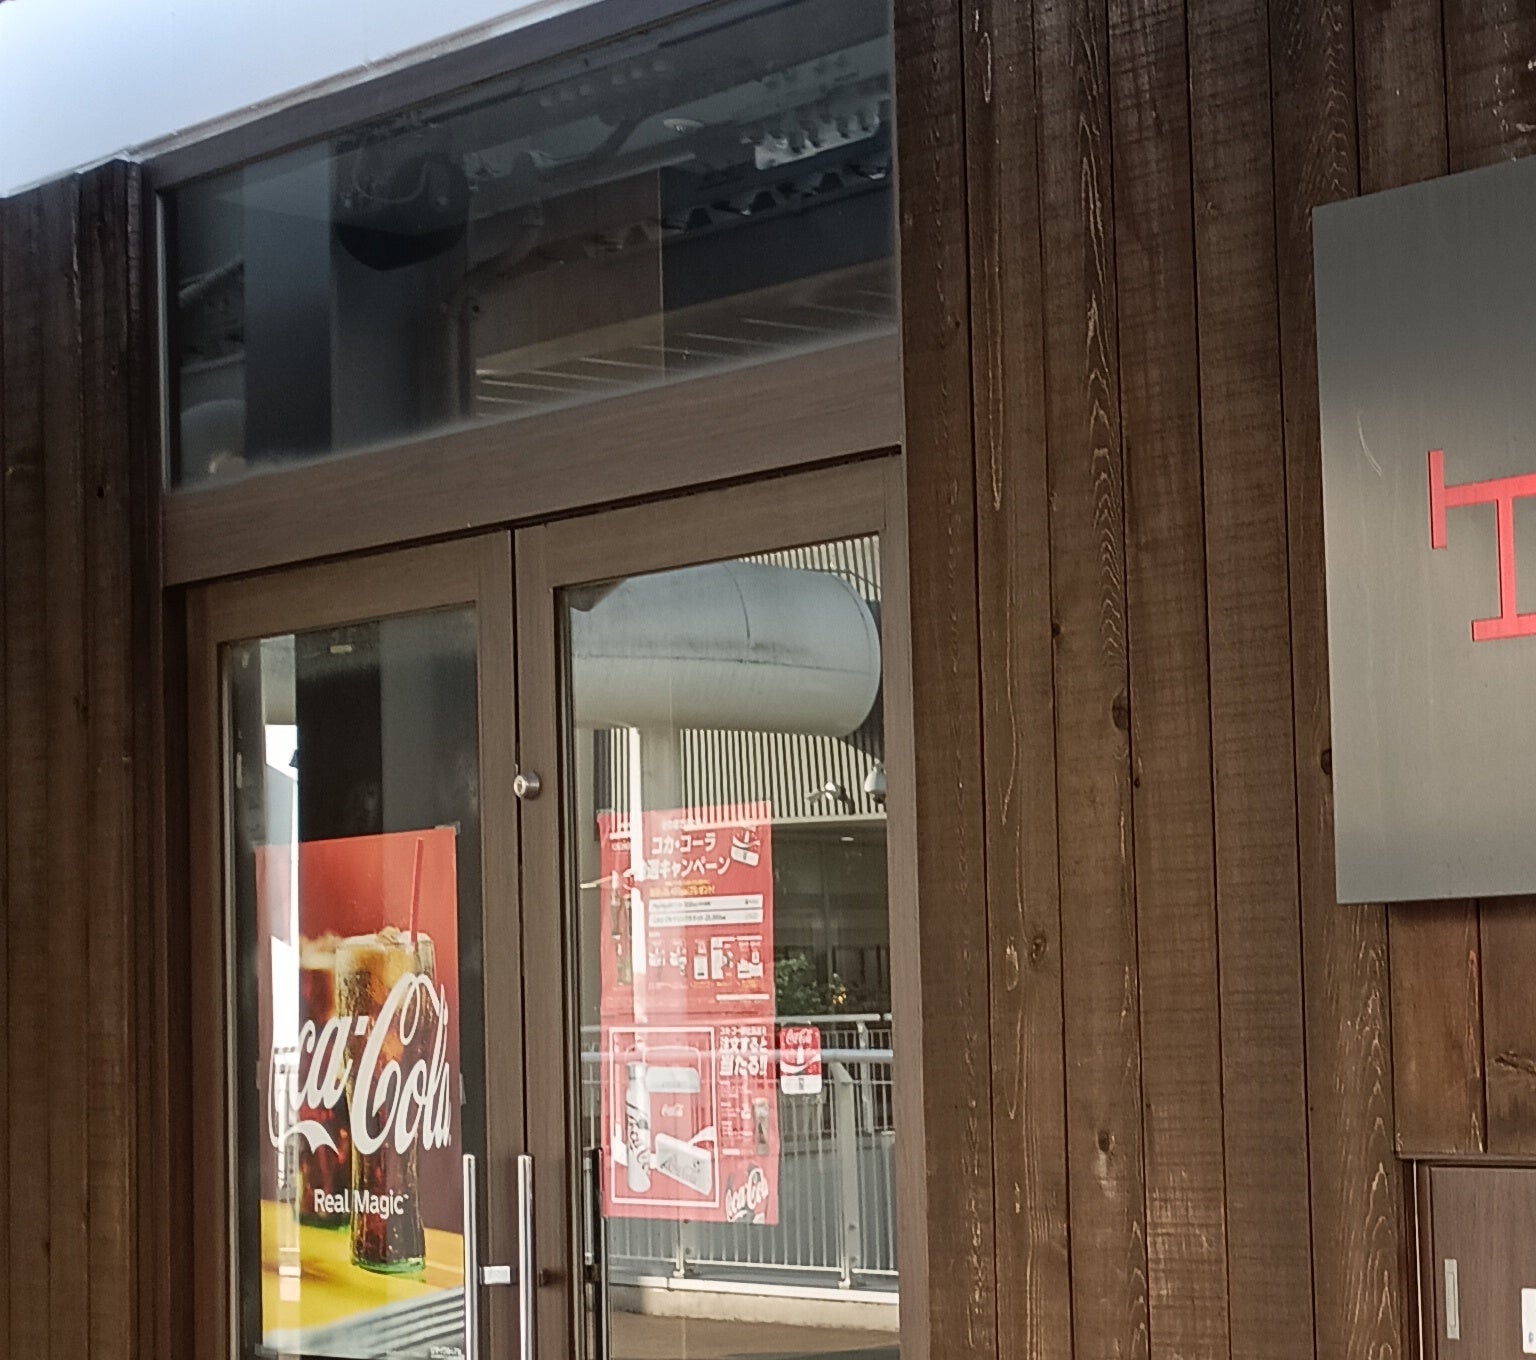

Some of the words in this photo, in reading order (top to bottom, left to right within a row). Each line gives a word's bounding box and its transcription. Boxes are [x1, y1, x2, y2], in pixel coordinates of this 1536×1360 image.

[651, 831, 716, 855] コカ・コーラ
[634, 855, 731, 880] 選キャンペーン
[313, 1188, 350, 1214] Real
[354, 1190, 404, 1219] Magic
